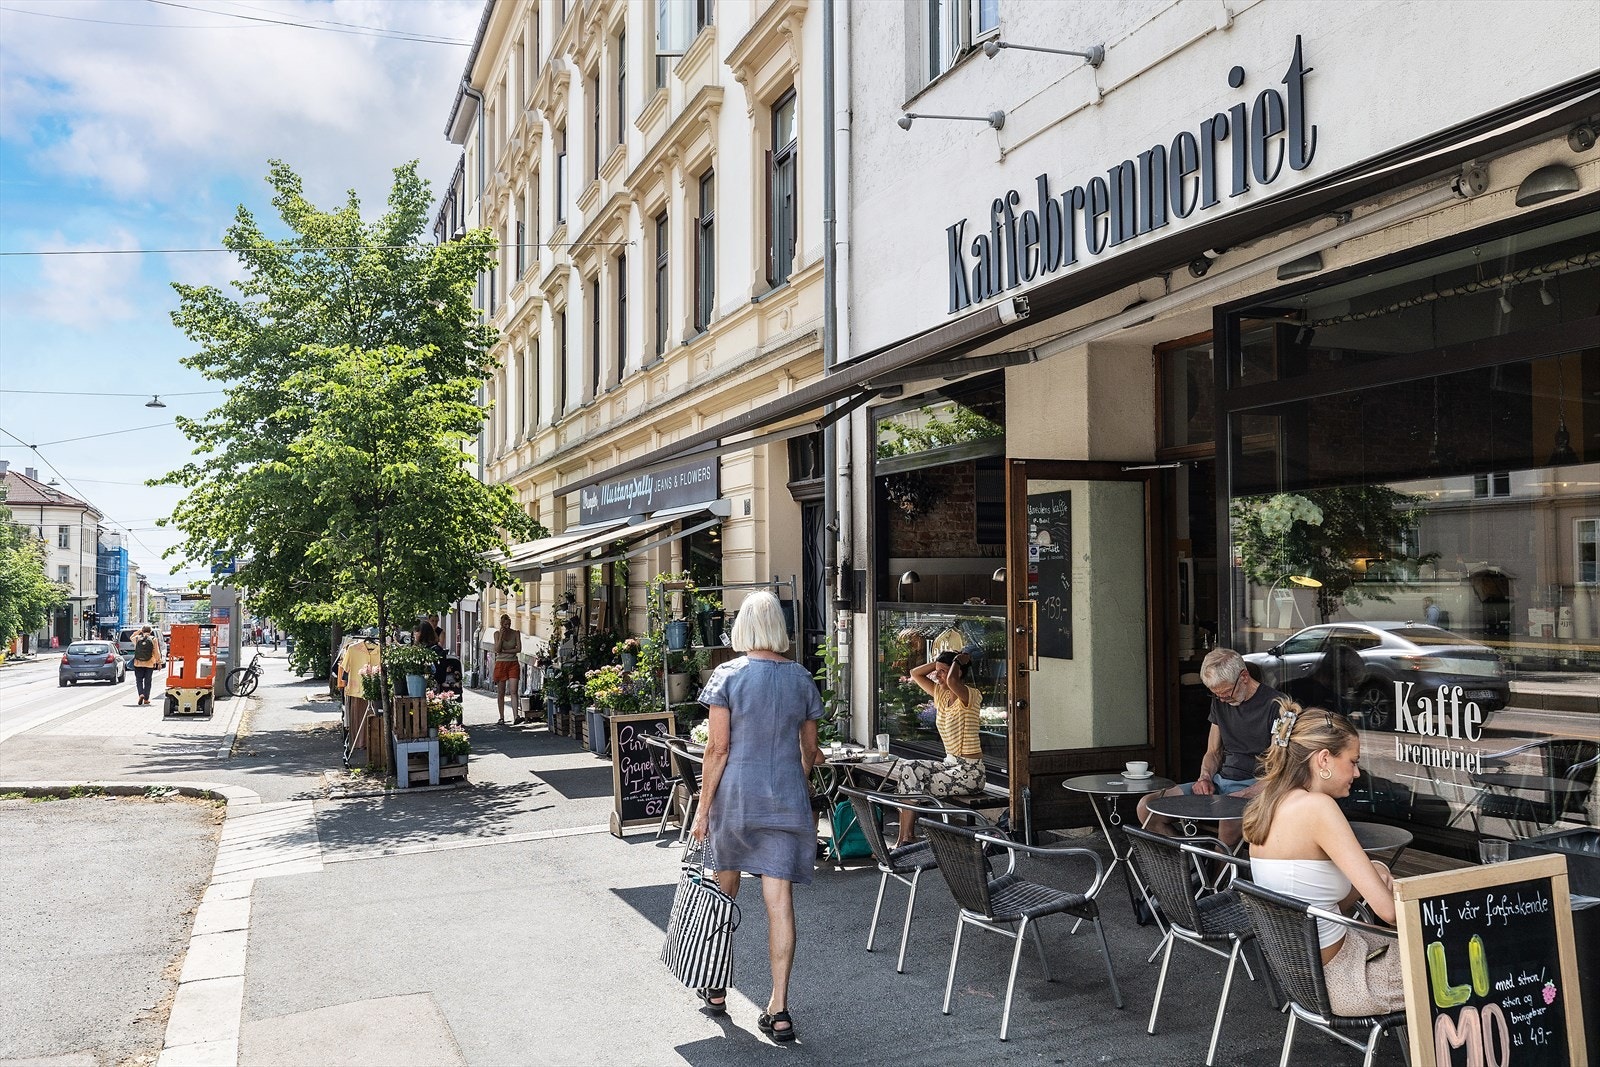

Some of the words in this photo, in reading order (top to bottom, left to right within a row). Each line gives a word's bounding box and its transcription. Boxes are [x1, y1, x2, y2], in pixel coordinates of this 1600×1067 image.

[946, 34, 1317, 315] Kaffebrenneriet
[654, 477, 673, 492] JEANS
[674, 475, 679, 488] &
[680, 466, 711, 486] FLOWERS
[1393, 680, 1482, 742] Kaffe
[1394, 736, 1483, 775] brenneriet
[630, 779, 652, 794] Ice
[1423, 899, 1450, 938] Nyt
[1458, 901, 1480, 920] vår
[1486, 890, 1548, 926] forfriskende
[1427, 934, 1490, 1008] LI
[1495, 973, 1515, 991] med
[1510, 1007, 1547, 1025] bringebær
[1523, 994, 1533, 1006] og
[1434, 1002, 1511, 1067] MO
[1513, 1033, 1524, 1046] til
